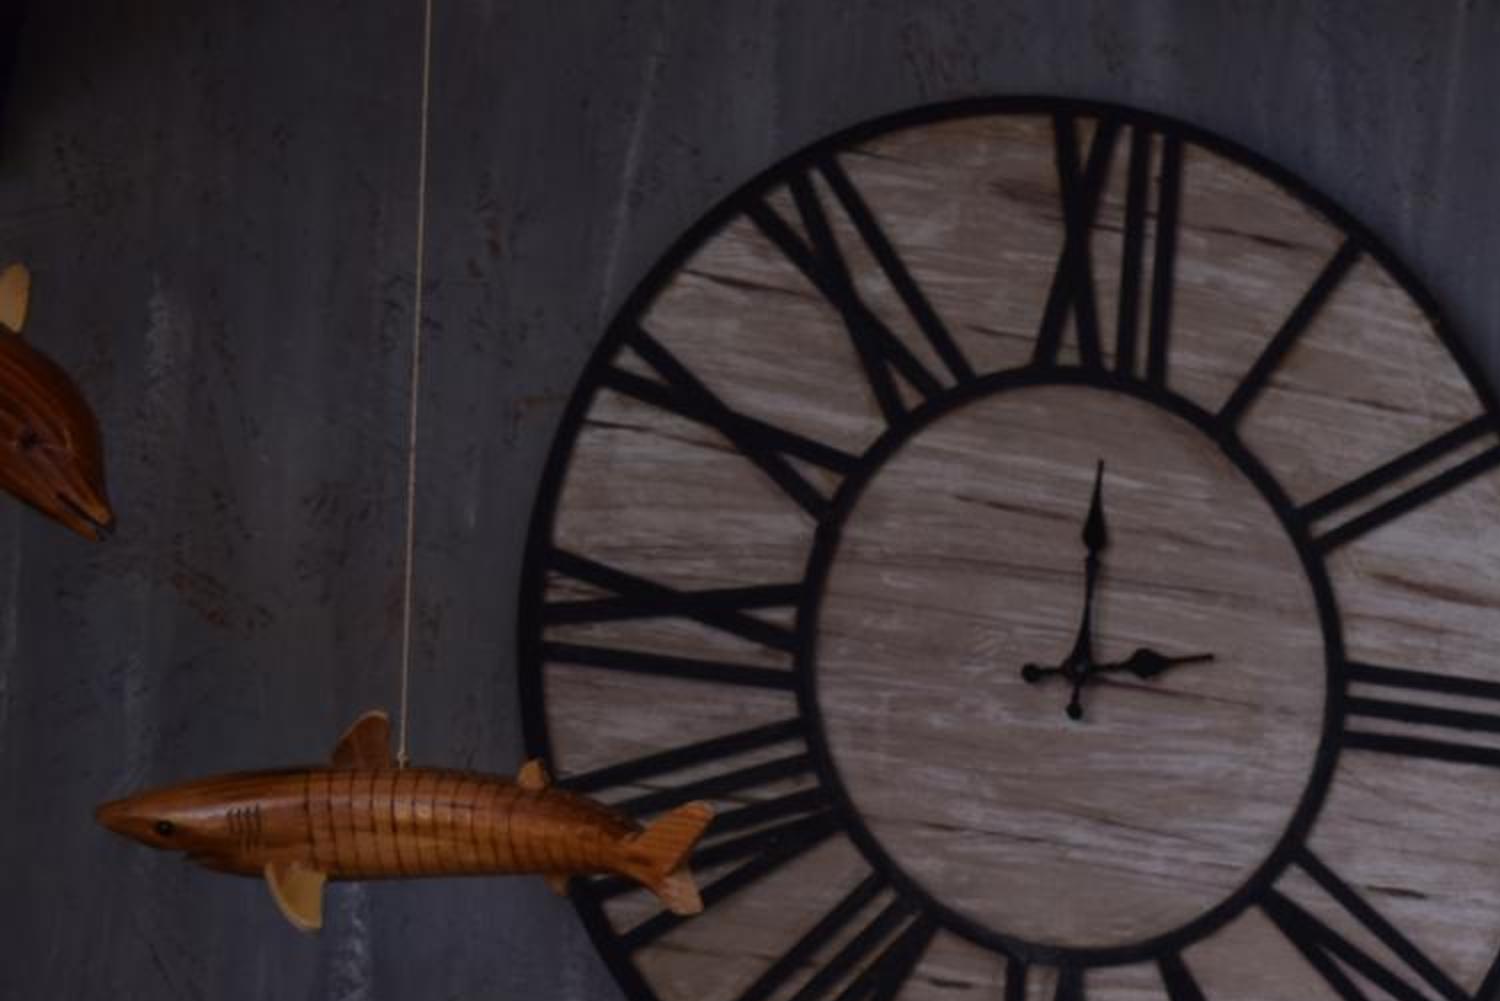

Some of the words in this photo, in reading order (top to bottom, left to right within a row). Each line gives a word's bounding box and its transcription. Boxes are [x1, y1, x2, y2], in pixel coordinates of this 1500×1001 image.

[740, 154, 977, 432] XI
[1033, 109, 1187, 384] XII
[597, 318, 871, 524] X
[541, 546, 806, 688] IX
